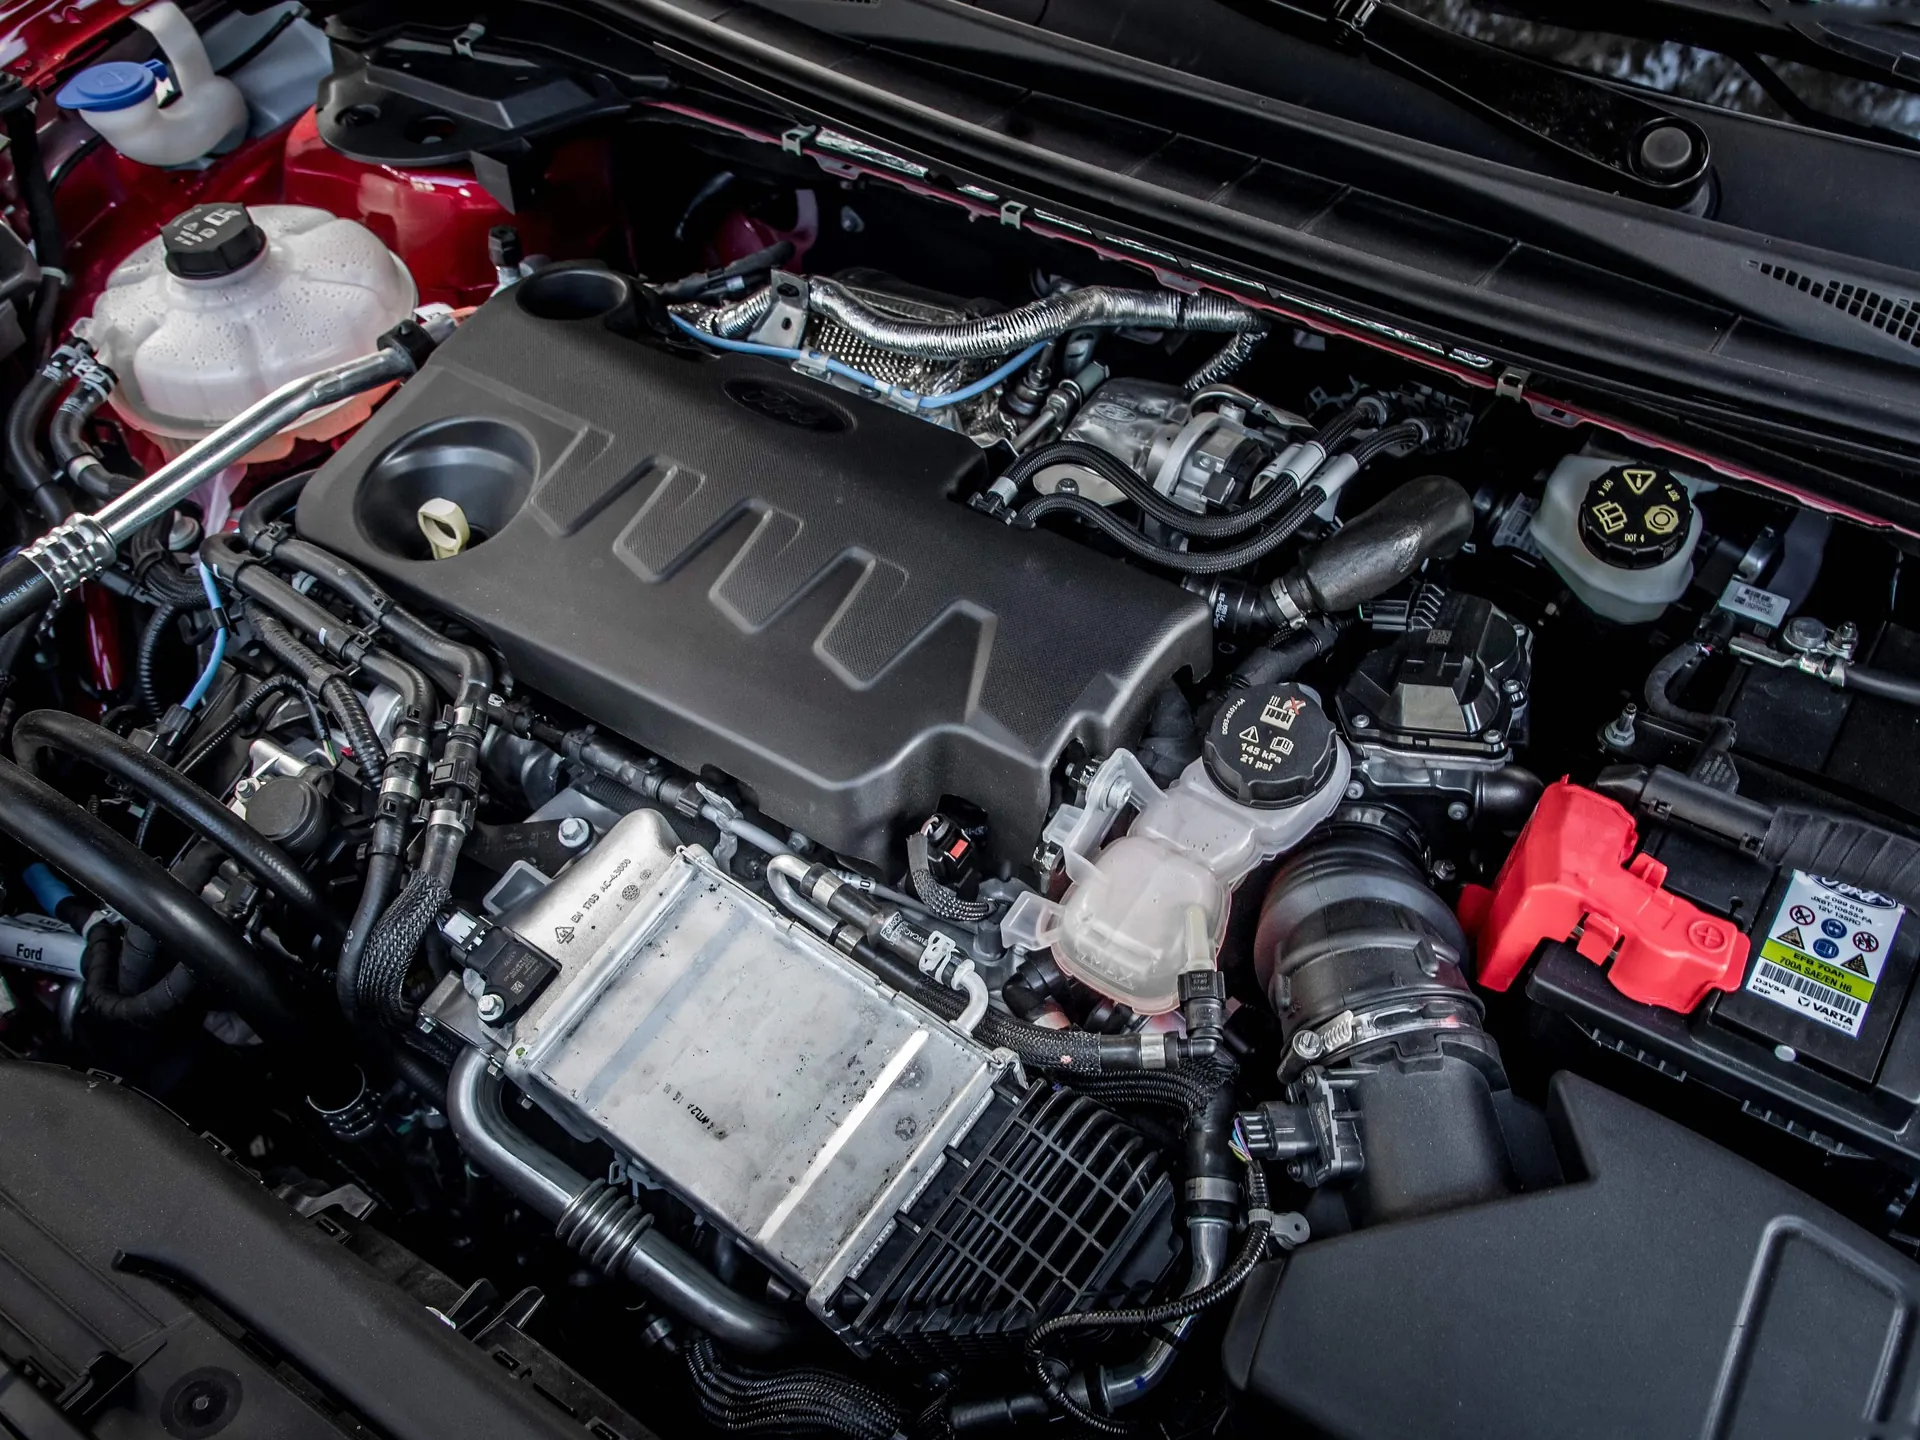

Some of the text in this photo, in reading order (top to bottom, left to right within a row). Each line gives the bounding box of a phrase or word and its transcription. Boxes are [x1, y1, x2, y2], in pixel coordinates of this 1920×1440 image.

[1624, 532, 1637, 542] DOT
[1240, 753, 1274, 772] 21 psi
[1241, 742, 1283, 765] 145 kPa
[16, 943, 43, 961] Ford
[1779, 955, 1802, 972] 700A
[1803, 965, 1838, 987] SAE/EN
[1793, 951, 1845, 980] EFB 70Ah
[1813, 1001, 1854, 1026] VARTA
